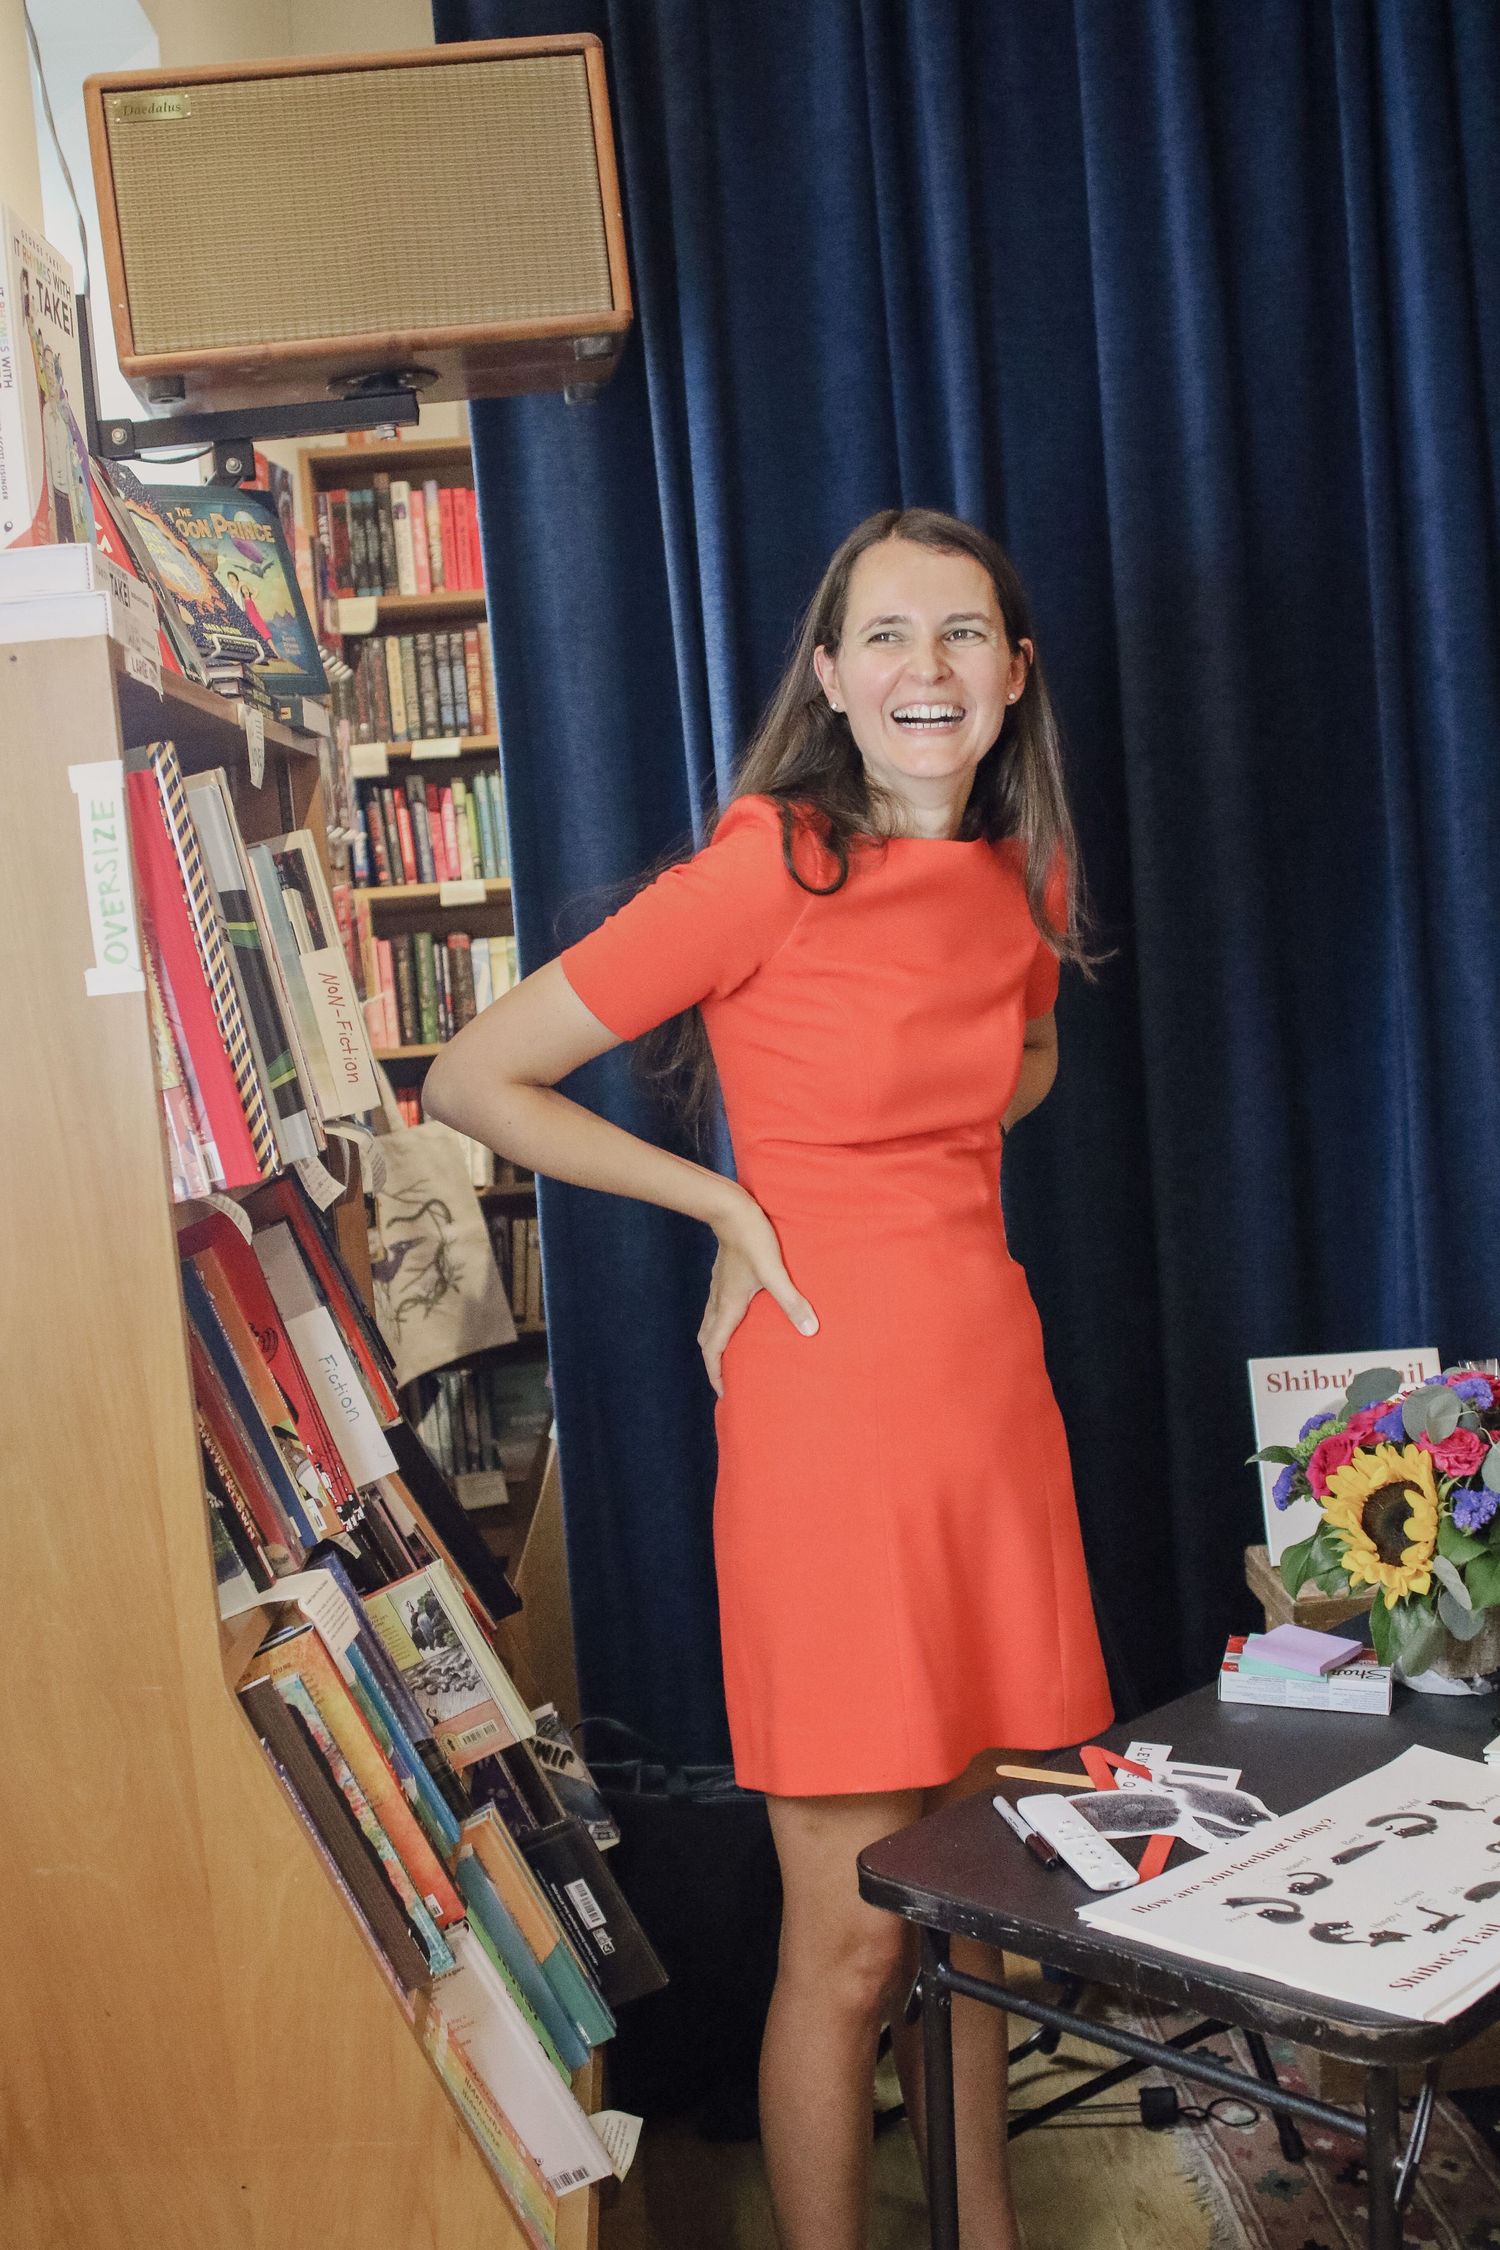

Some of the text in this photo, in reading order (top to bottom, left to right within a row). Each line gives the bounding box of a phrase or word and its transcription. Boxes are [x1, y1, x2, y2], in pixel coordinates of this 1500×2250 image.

[122, 101, 182, 117] Daedalus
[52, 271, 72, 302] WITH
[36, 278, 74, 339] TAKEI
[2, 356, 13, 388] WITH
[175, 506, 193, 518] THE
[210, 512, 276, 543] PRINCE
[91, 800, 129, 965] OVERSIZE
[318, 1354, 360, 1423] Fiction
[1267, 1368, 1352, 1393] Shibu'
[1131, 1817, 1337, 1914] How are you feeling today?
[1389, 1922, 1500, 1992] Shibu's Tail
